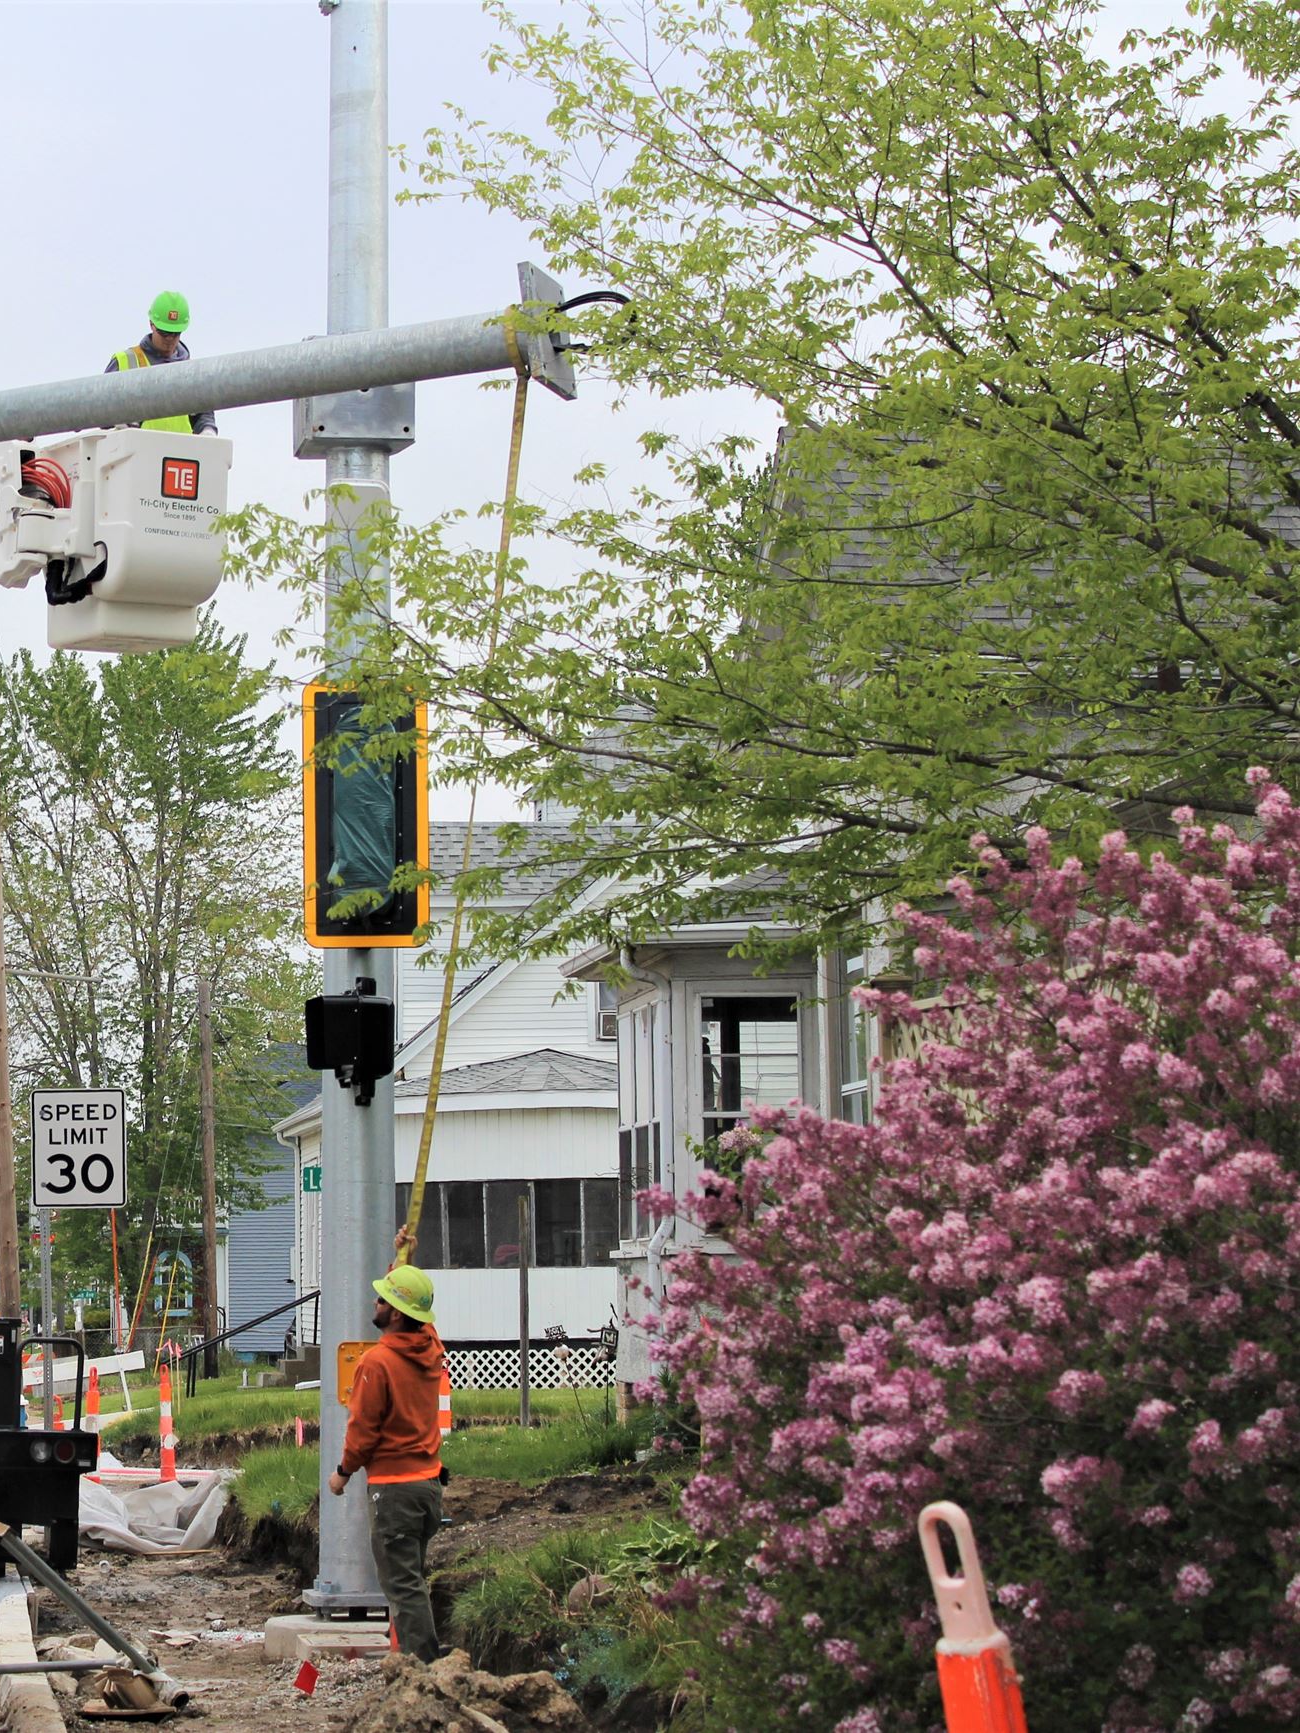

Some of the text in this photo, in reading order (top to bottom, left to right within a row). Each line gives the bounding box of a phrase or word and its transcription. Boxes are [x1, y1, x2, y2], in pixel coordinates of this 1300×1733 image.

[140, 498, 221, 515] Tri-City Electric Co.
[144, 527, 180, 536] CONFIDENCE
[40, 1104, 117, 1121] SPEED
[49, 1128, 108, 1145] LIMIT
[46, 1153, 115, 1194] 30
